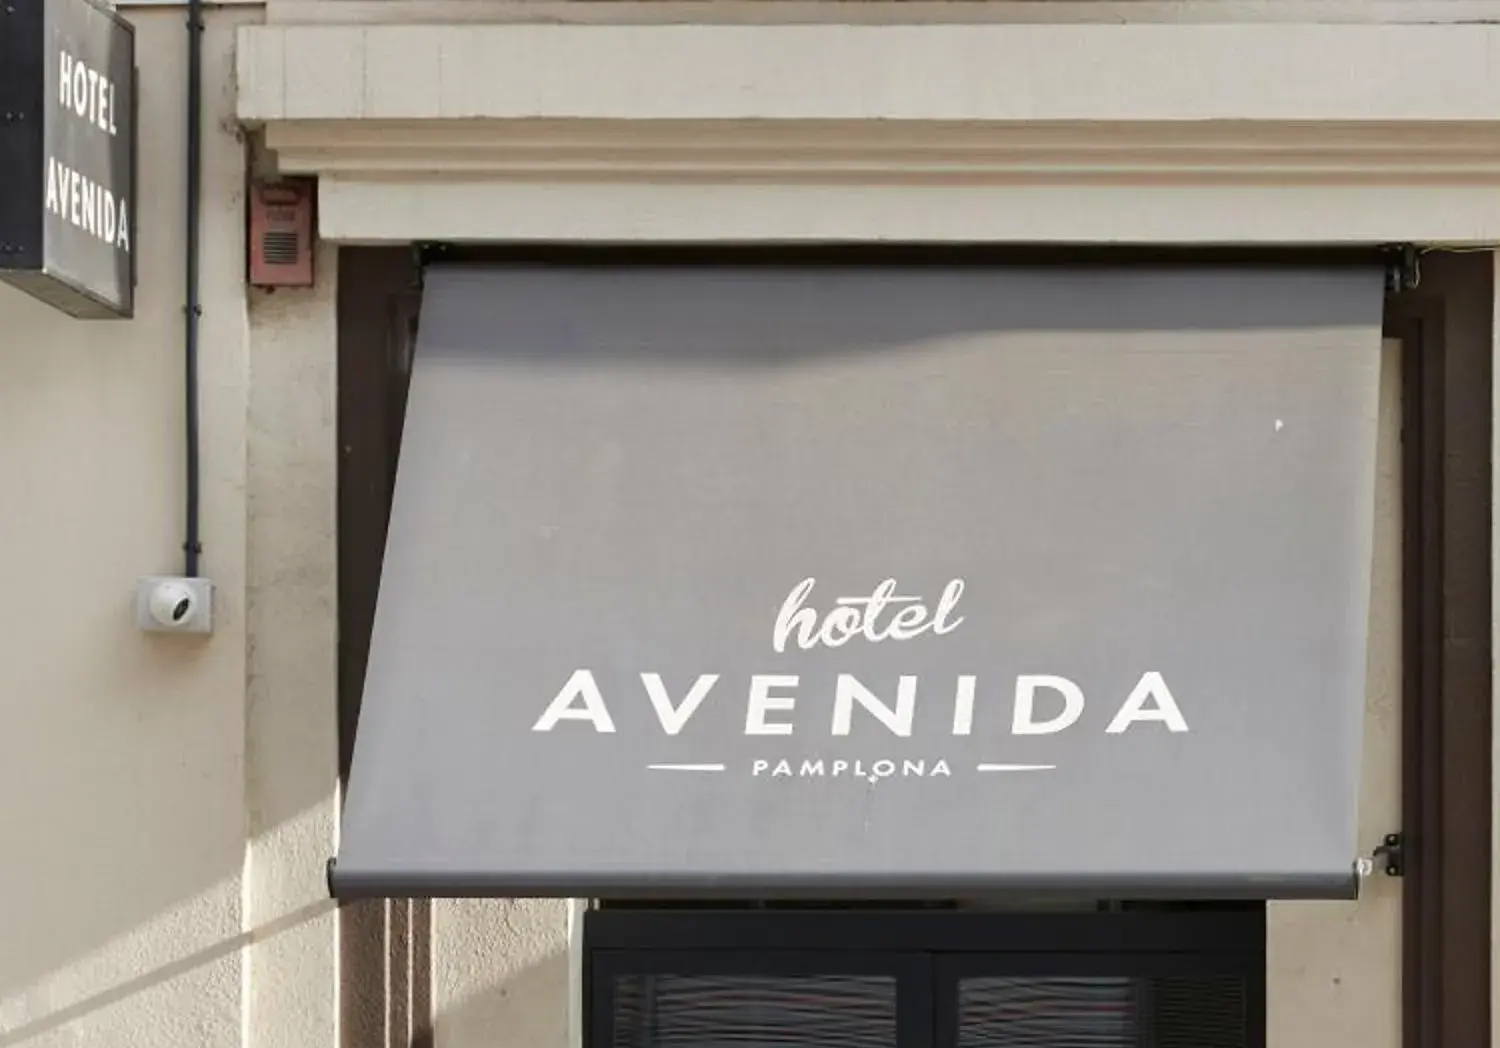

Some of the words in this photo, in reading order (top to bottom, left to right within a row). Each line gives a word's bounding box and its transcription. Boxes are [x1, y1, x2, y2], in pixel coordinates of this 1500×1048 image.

[59, 50, 117, 136] HOTEL
[46, 156, 129, 252] AVENIDA
[773, 577, 965, 653] hotel
[531, 669, 1189, 737] AVENIDA
[752, 759, 951, 778] PAMPLONA
